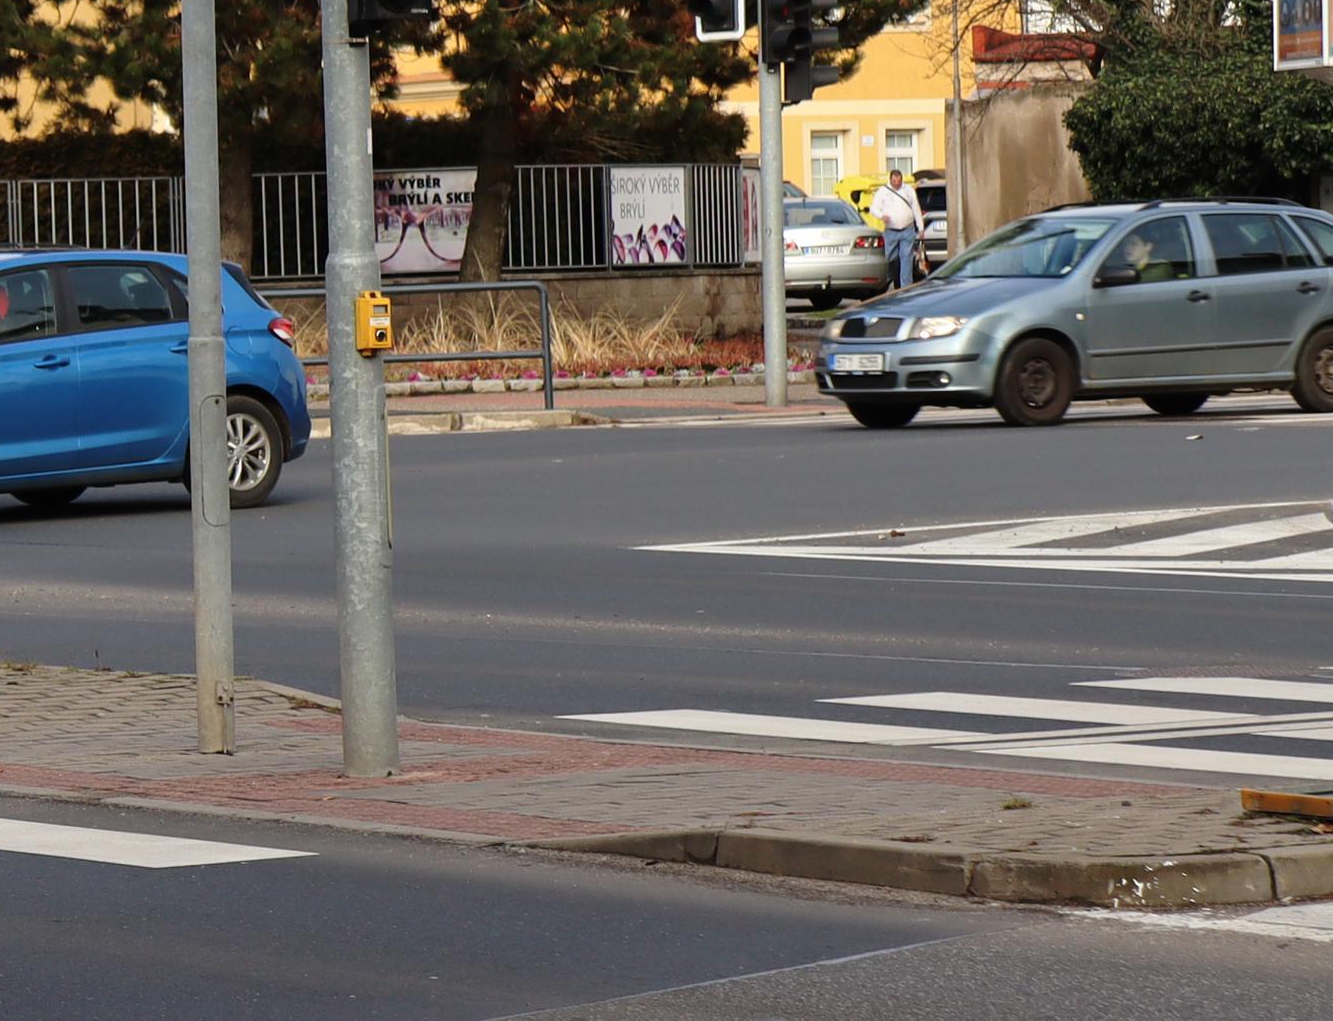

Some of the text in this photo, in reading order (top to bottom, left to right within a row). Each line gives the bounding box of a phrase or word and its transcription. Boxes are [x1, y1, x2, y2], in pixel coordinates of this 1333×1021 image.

[398, 174, 441, 190] VÝBĚR
[610, 173, 681, 195] ŠIROKÝ VÝBĚR
[388, 189, 428, 206] BRÝLÍ
[432, 192, 443, 205] A
[620, 199, 646, 220] BRÝLÍ
